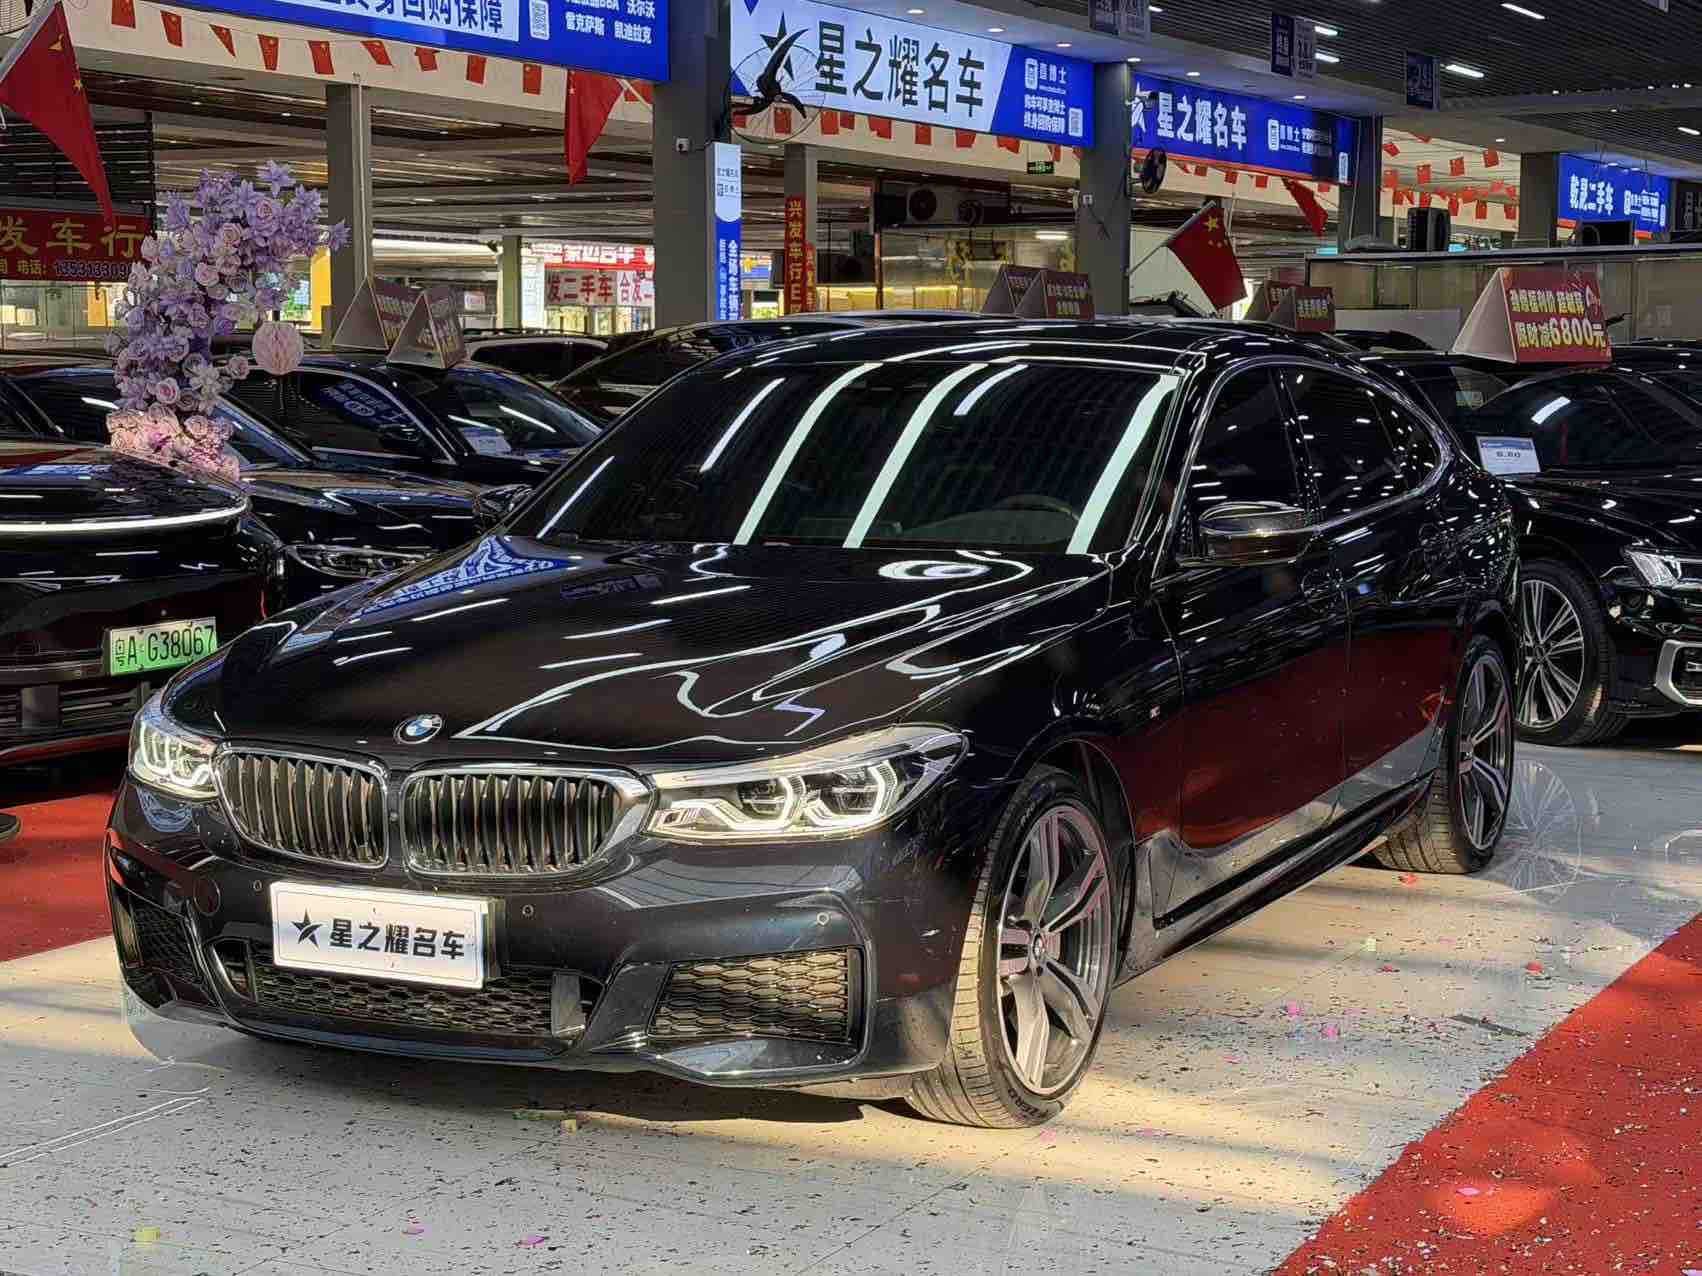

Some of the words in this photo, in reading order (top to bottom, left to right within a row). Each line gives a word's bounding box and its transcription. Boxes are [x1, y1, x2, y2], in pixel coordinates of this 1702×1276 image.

[338, 0, 503, 33] 回购保障
[565, 11, 604, 36] 雷克萨斯
[815, 20, 985, 118] 星之耀名车
[1157, 91, 1247, 150] 星之耀名车
[327, 917, 466, 961] 星之耀名车
